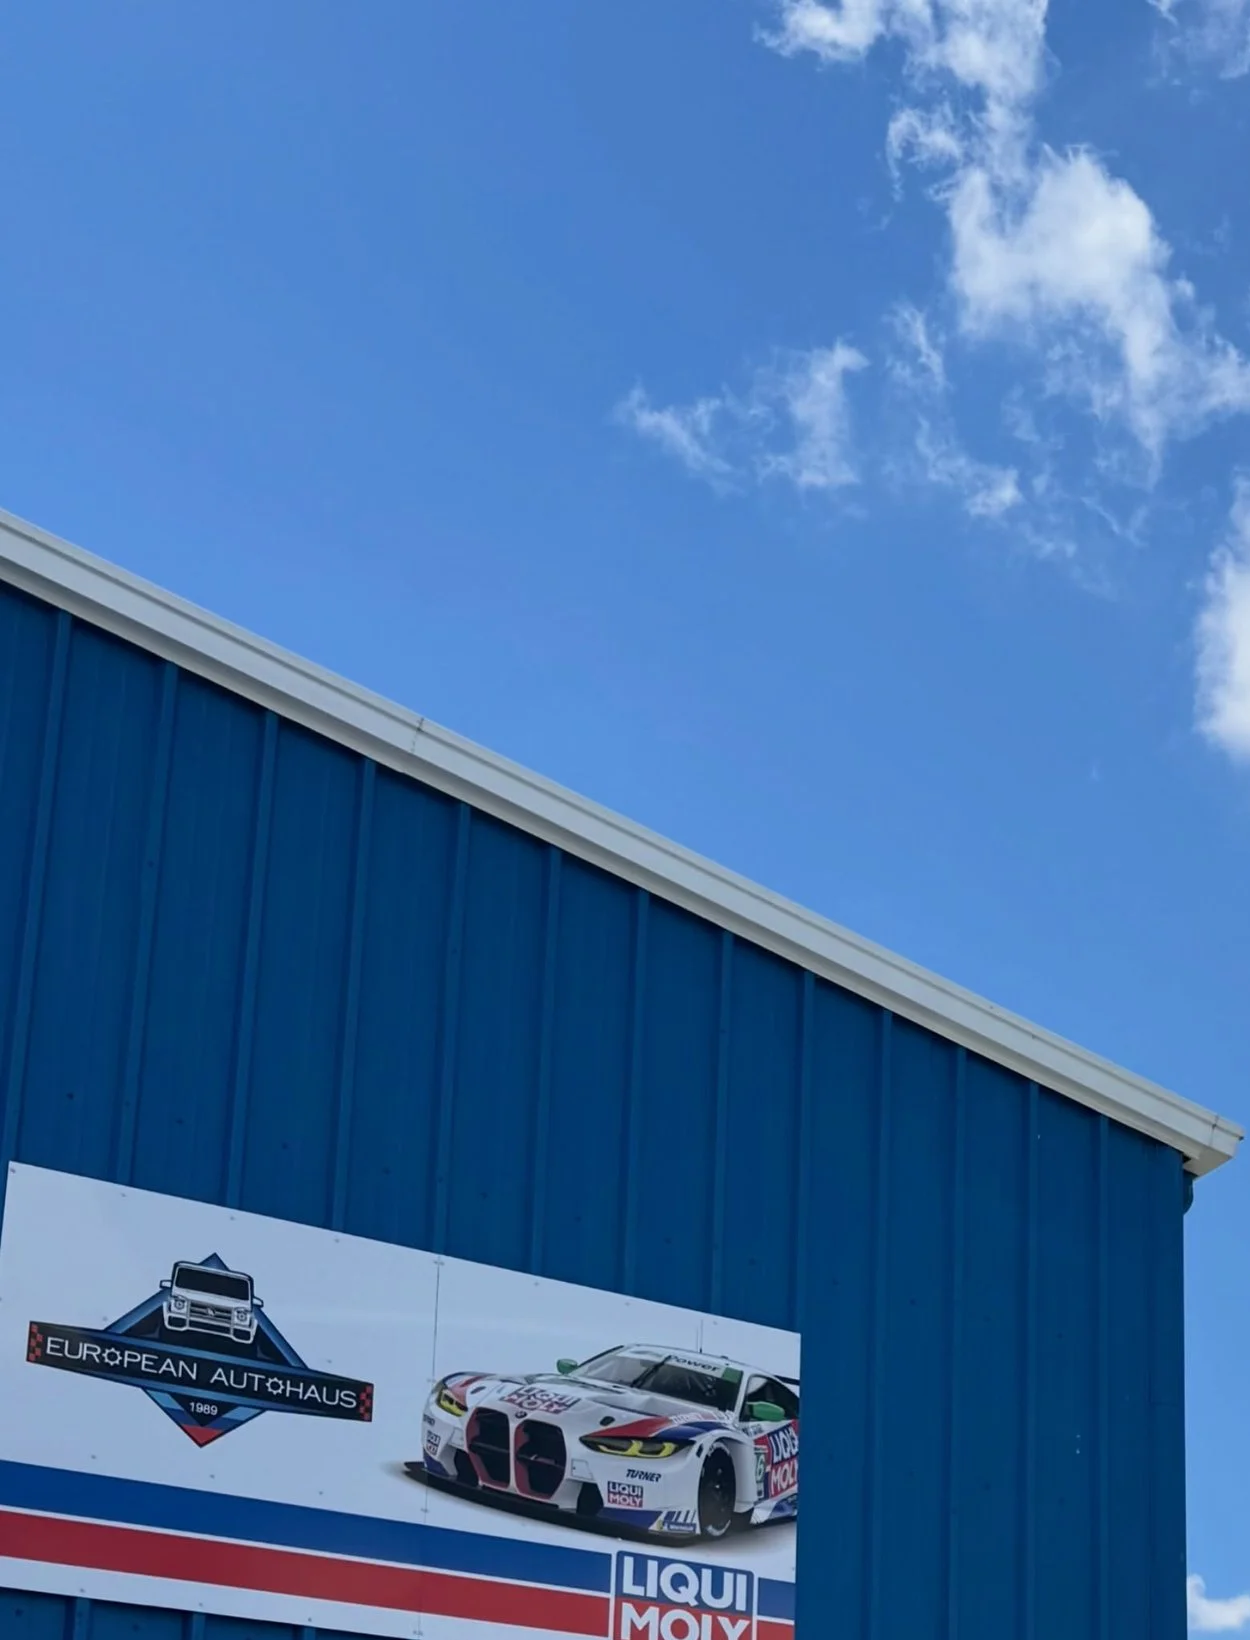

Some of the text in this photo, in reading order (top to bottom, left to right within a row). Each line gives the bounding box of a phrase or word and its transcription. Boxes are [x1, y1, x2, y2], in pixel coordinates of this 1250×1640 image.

[189, 1402, 218, 1416] 1989
[626, 1469, 662, 1482] TURNER
[609, 1483, 642, 1495] LIQUI
[609, 1493, 642, 1506] MOLY
[622, 1556, 747, 1611] LIQUI
